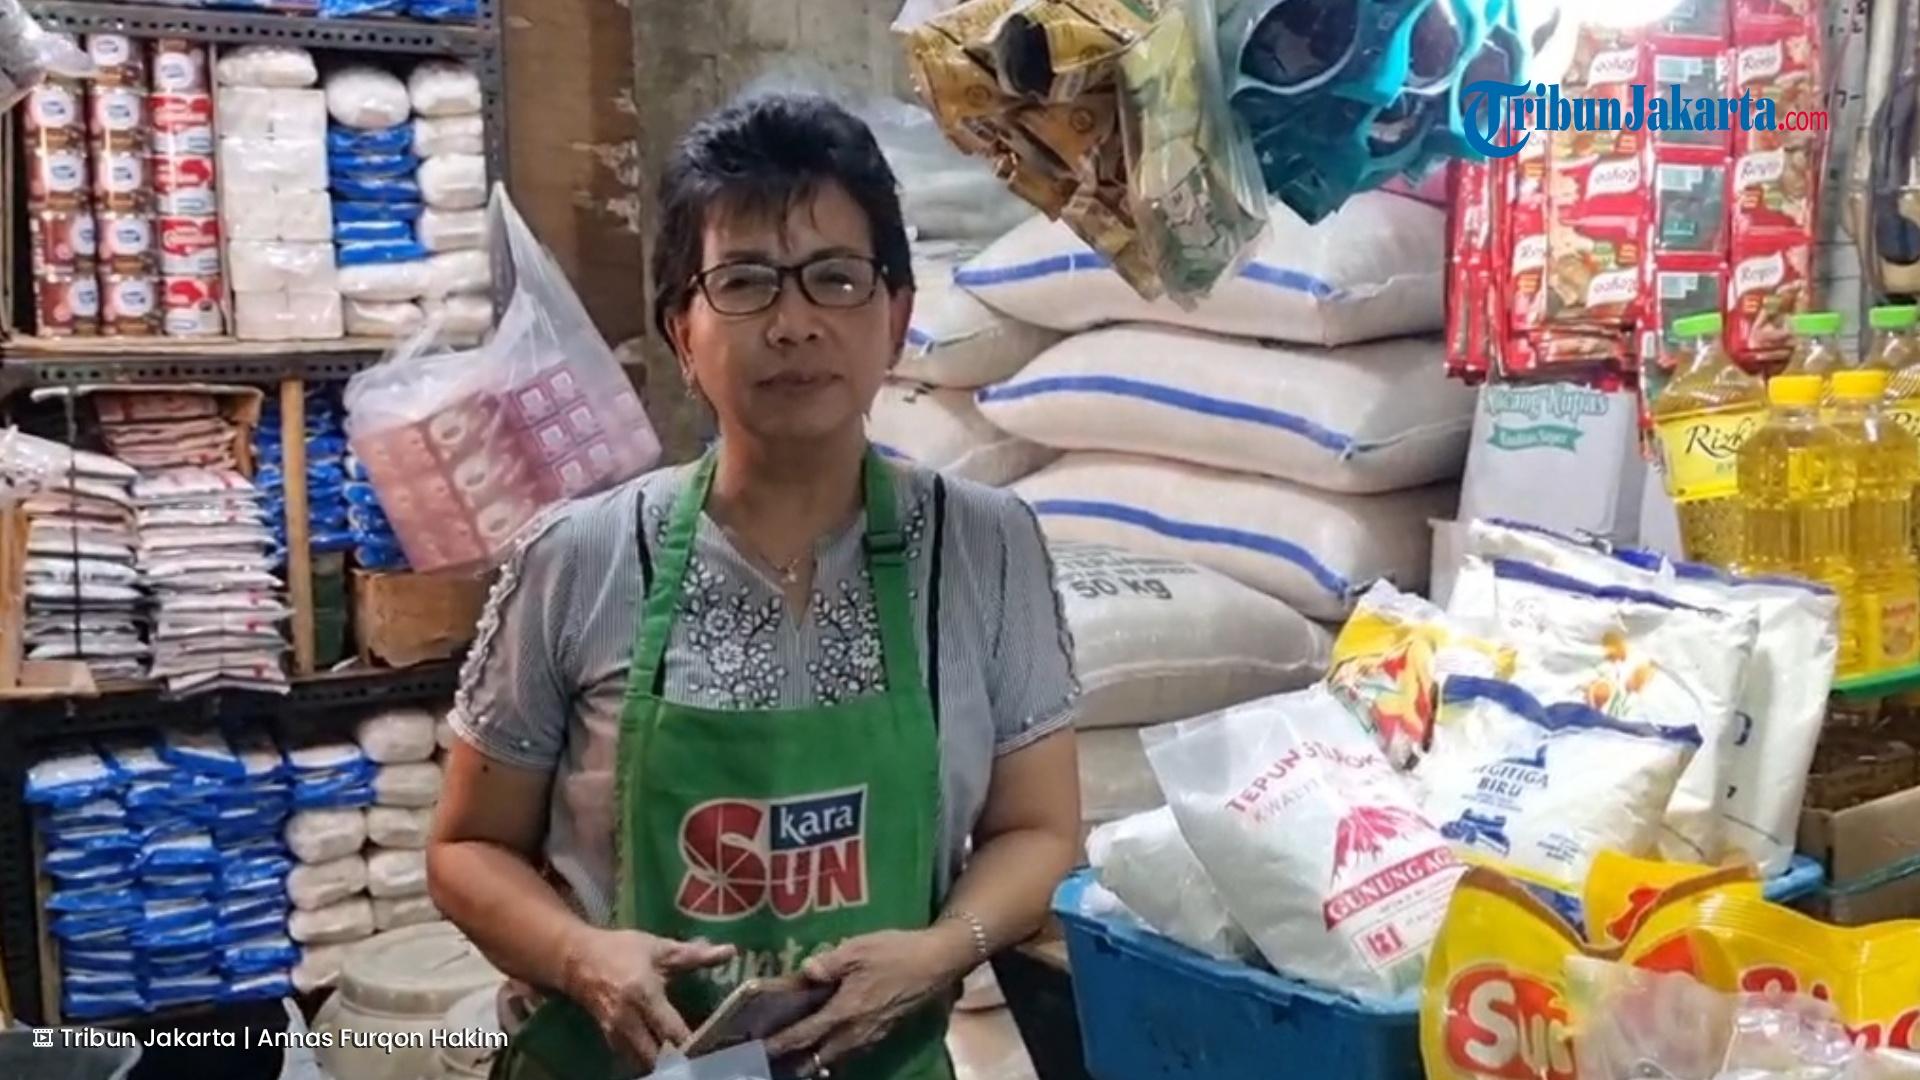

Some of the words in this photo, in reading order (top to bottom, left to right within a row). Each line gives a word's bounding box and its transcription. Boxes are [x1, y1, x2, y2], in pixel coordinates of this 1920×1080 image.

[1070, 578, 1119, 599] 50
[1118, 576, 1173, 600] kg
[1477, 776, 1524, 798] BIRU
[778, 802, 854, 845] kara
[1327, 861, 1425, 921] GUNUNG
